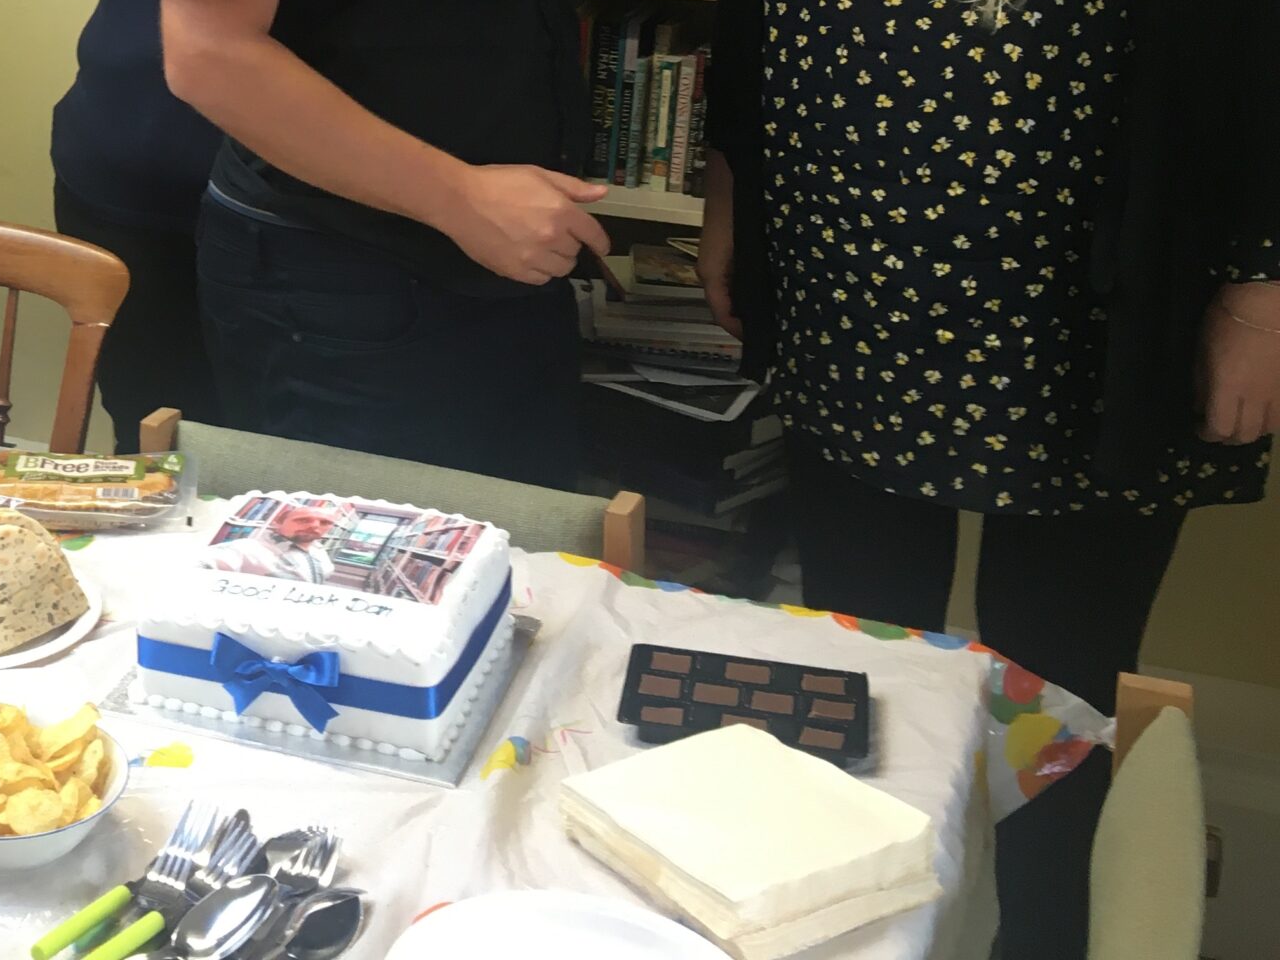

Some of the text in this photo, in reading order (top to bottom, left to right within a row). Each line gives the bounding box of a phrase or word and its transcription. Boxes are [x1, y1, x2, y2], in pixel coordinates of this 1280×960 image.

[23, 455, 89, 473] BFree
[212, 578, 393, 617] Good Luck Dan
